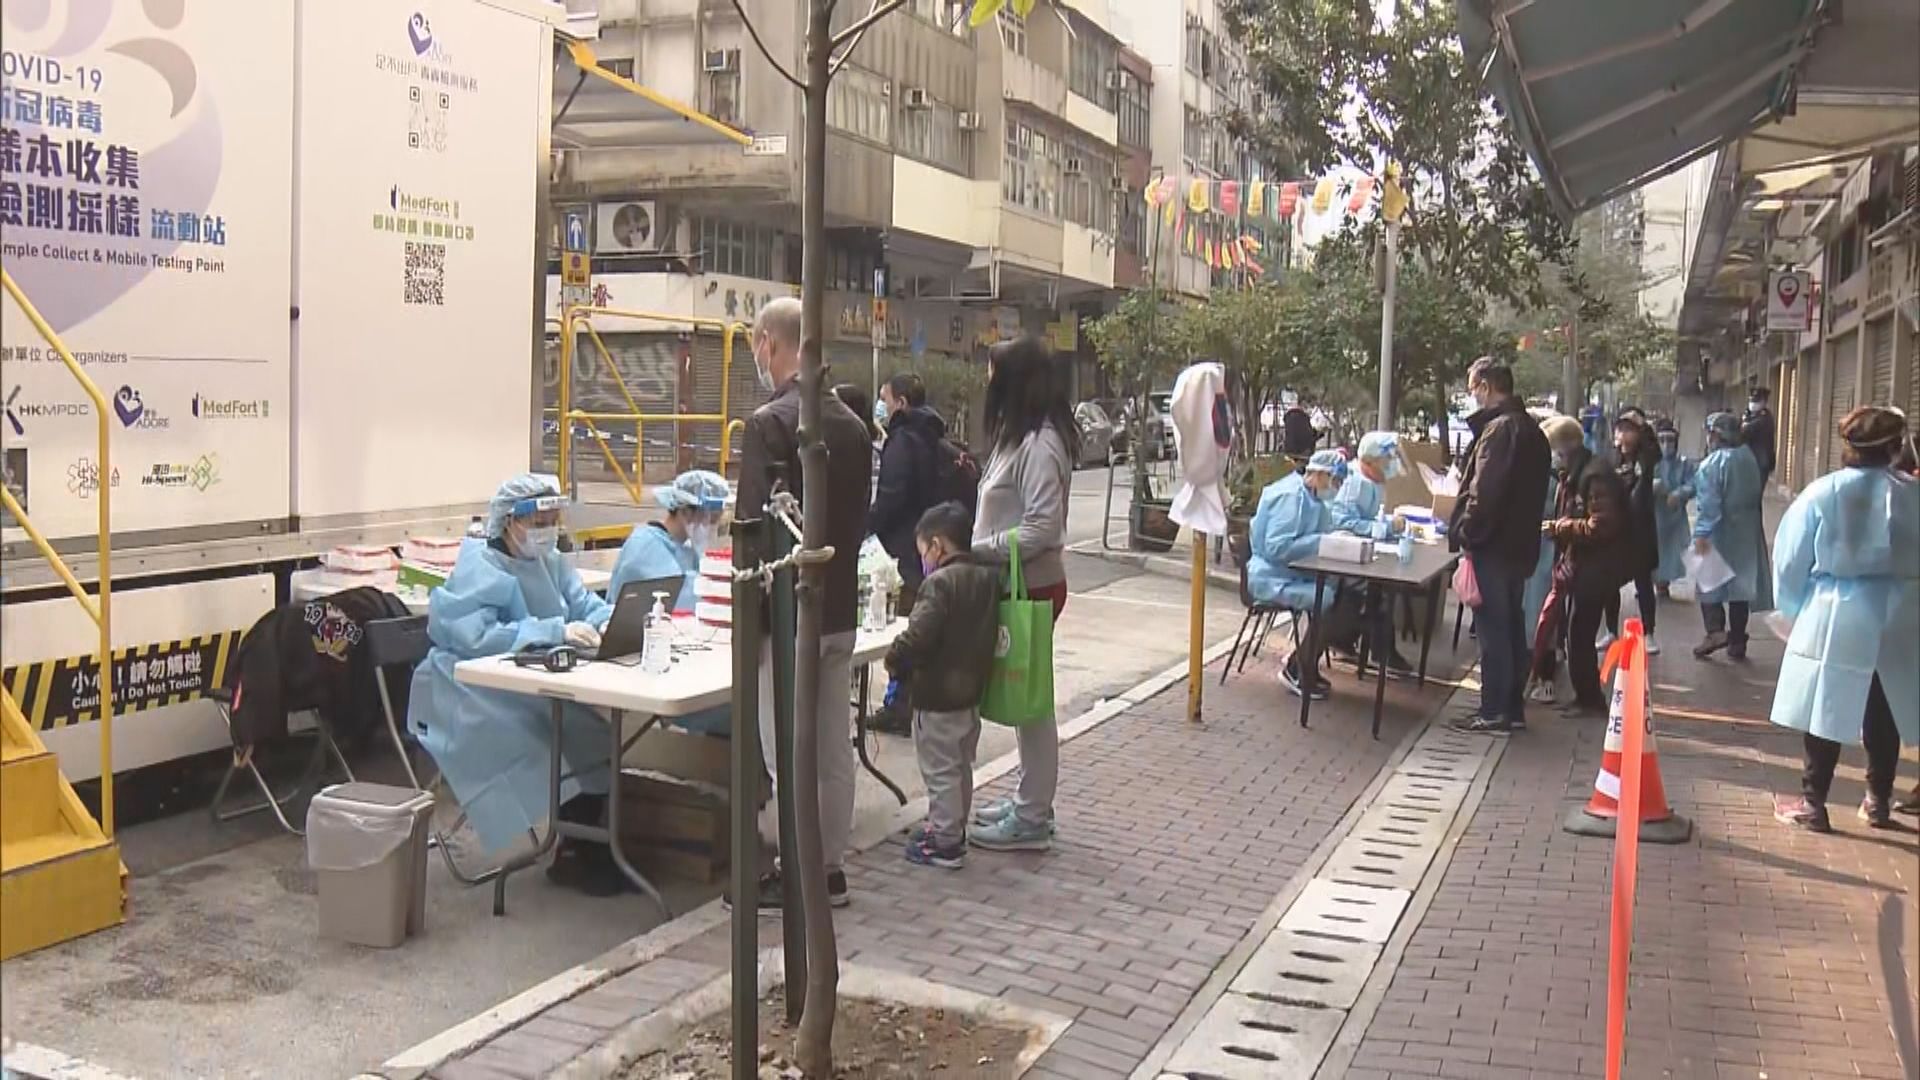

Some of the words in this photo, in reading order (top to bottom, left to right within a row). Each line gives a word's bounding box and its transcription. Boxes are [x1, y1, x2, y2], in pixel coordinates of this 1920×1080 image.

[151, 208, 226, 246] 流動站
[43, 244, 89, 262] Collect
[93, 249, 102, 263] &
[107, 250, 147, 267] Mobile
[151, 255, 193, 273] Testing
[196, 258, 225, 273] Point
[19, 403, 89, 416] HKMPDC
[203, 400, 258, 414] MedFort
[135, 417, 169, 428] ADORE
[71, 691, 117, 710] Cautn
[128, 686, 144, 699] Do
[147, 682, 167, 695] Not
[169, 675, 202, 692] Touch
